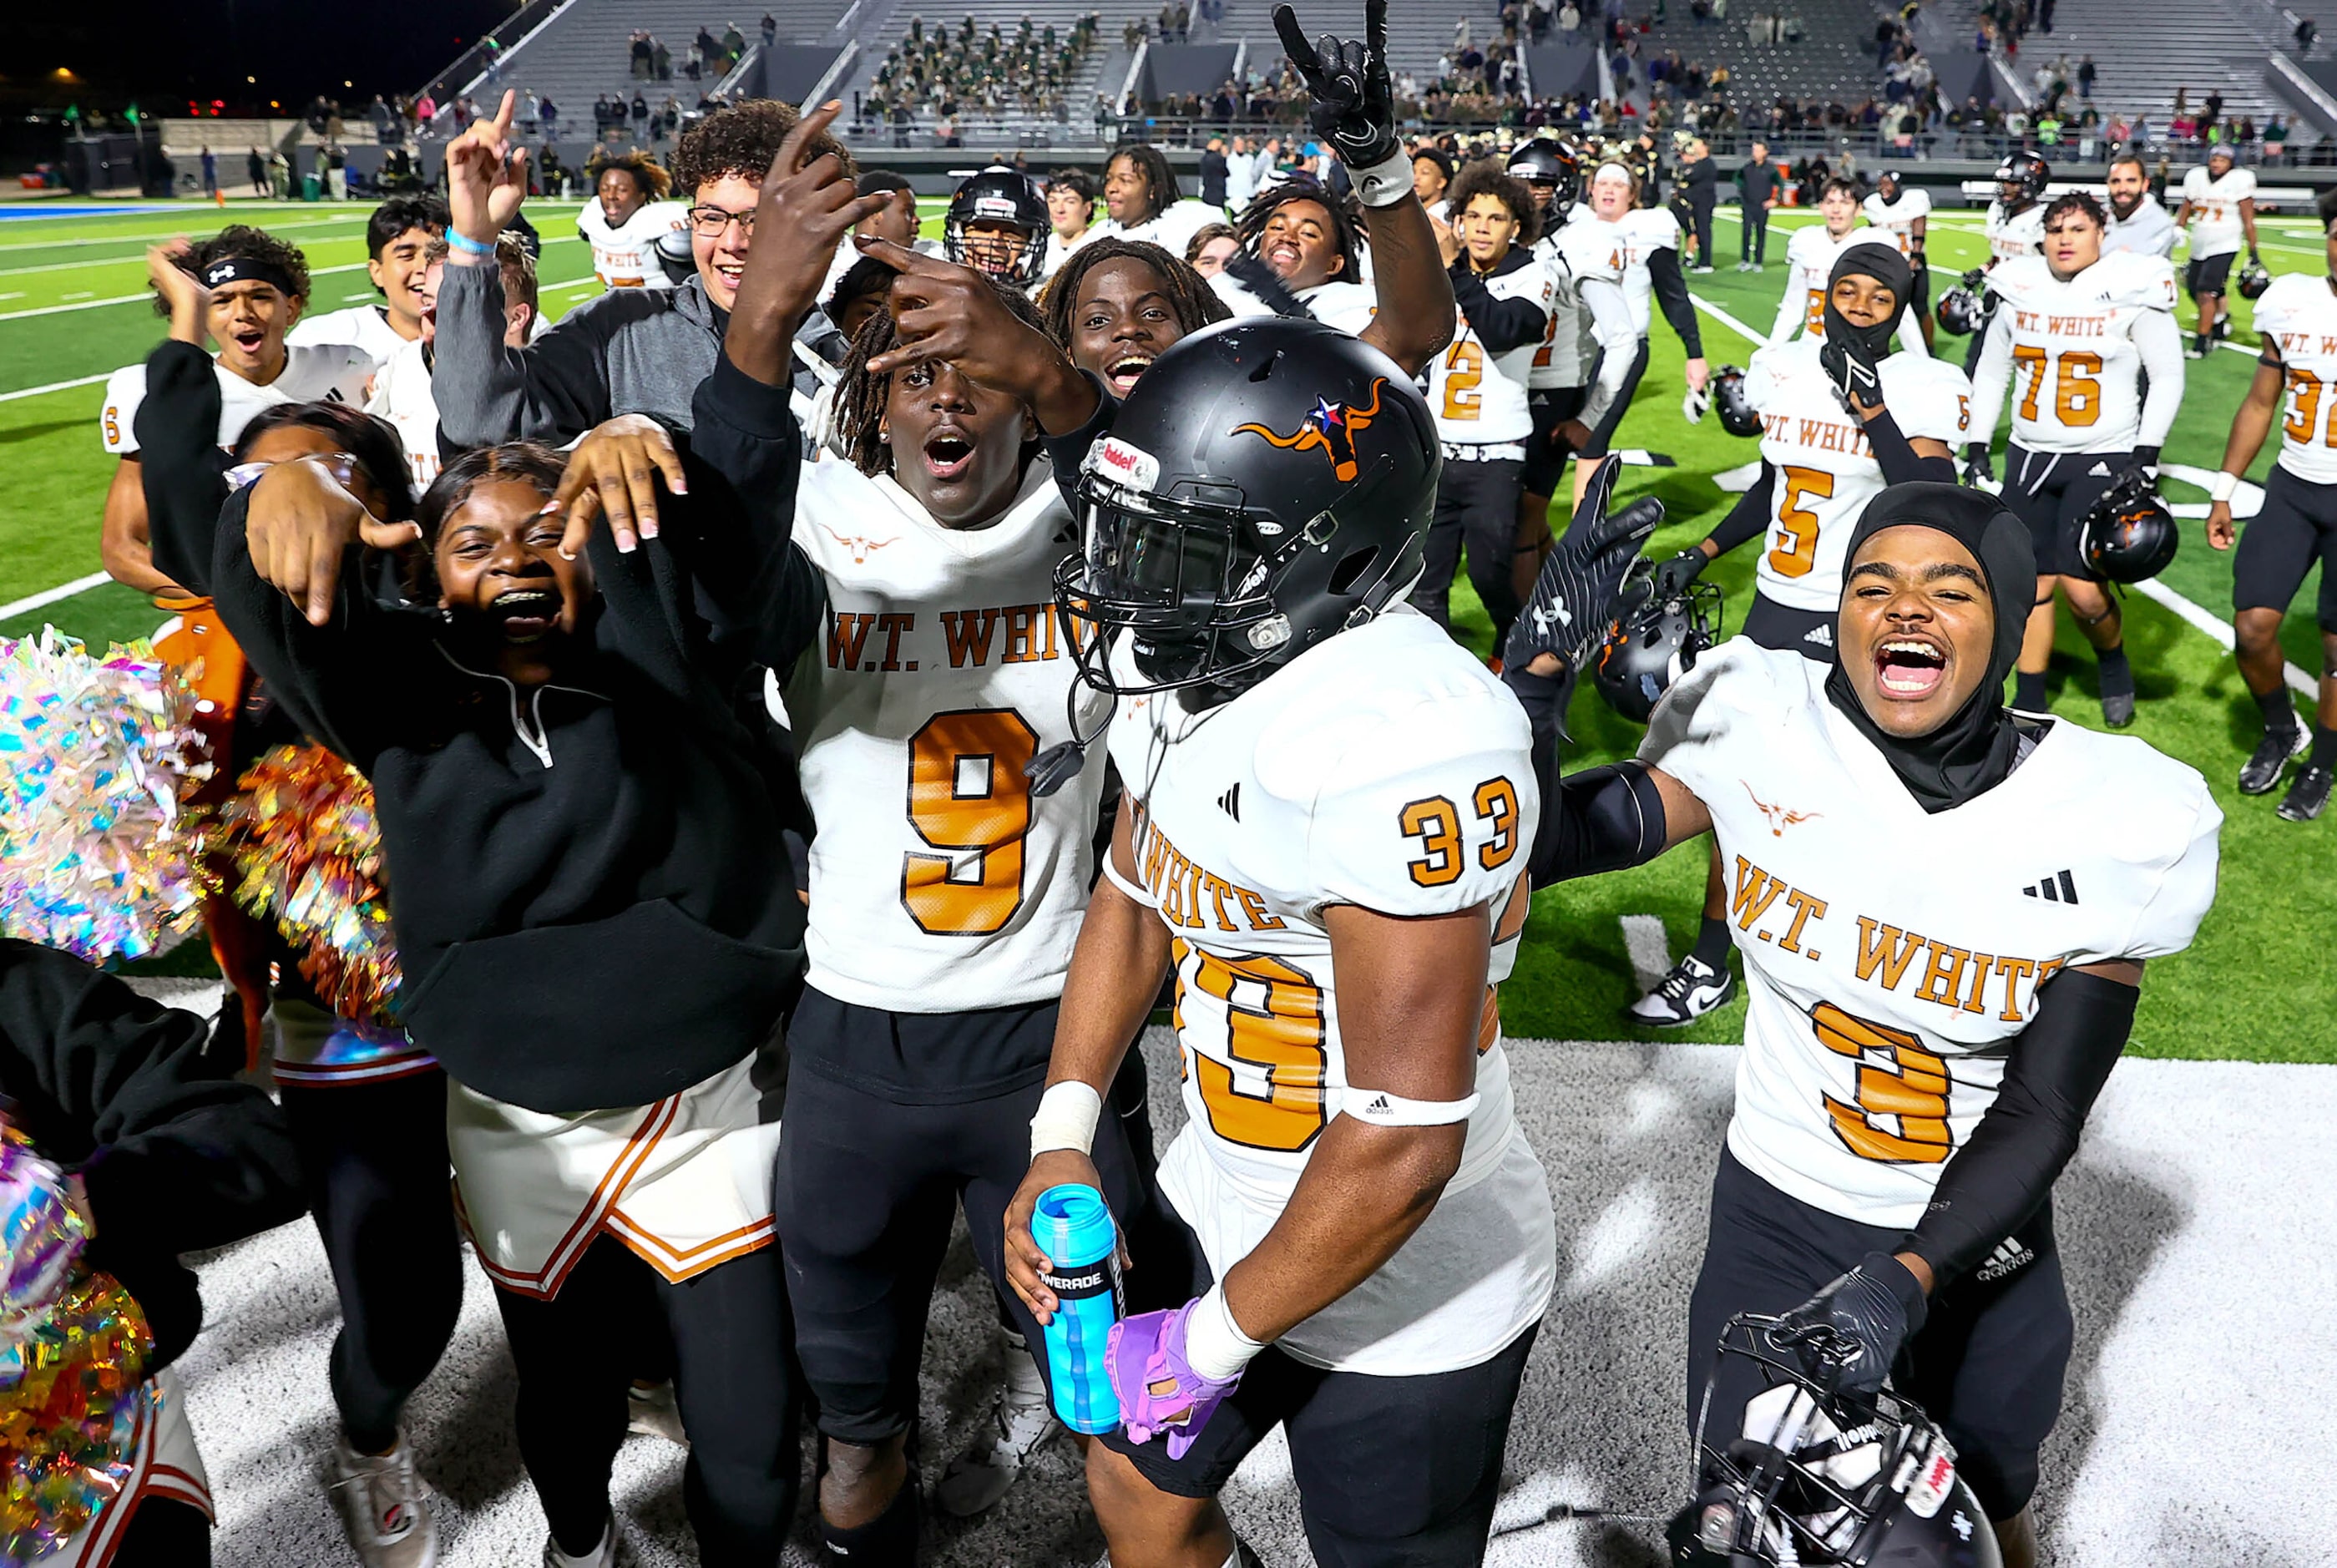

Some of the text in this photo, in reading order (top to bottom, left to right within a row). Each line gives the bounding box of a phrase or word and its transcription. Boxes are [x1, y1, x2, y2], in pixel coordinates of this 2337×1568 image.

[2047, 315, 2106, 336] WHITE
[1441, 341, 1484, 421] 2
[1956, 394, 1970, 432] 5
[2013, 343, 2103, 427] 76
[105, 406, 121, 446] 6
[1768, 464, 1834, 579] 5
[827, 598, 1100, 672] W.T. WHIT
[900, 706, 1041, 937] 9
[1397, 775, 1520, 888] 33
[1145, 819, 1289, 933] WHITE
[1732, 853, 1829, 962] W.T.
[1171, 935, 1328, 1154] 3
[1806, 999, 1955, 1165] 3
[1366, 1107, 1394, 1115] adidas
[1036, 1268, 1101, 1290] WERADE
[1976, 1248, 2035, 1282] adidas
